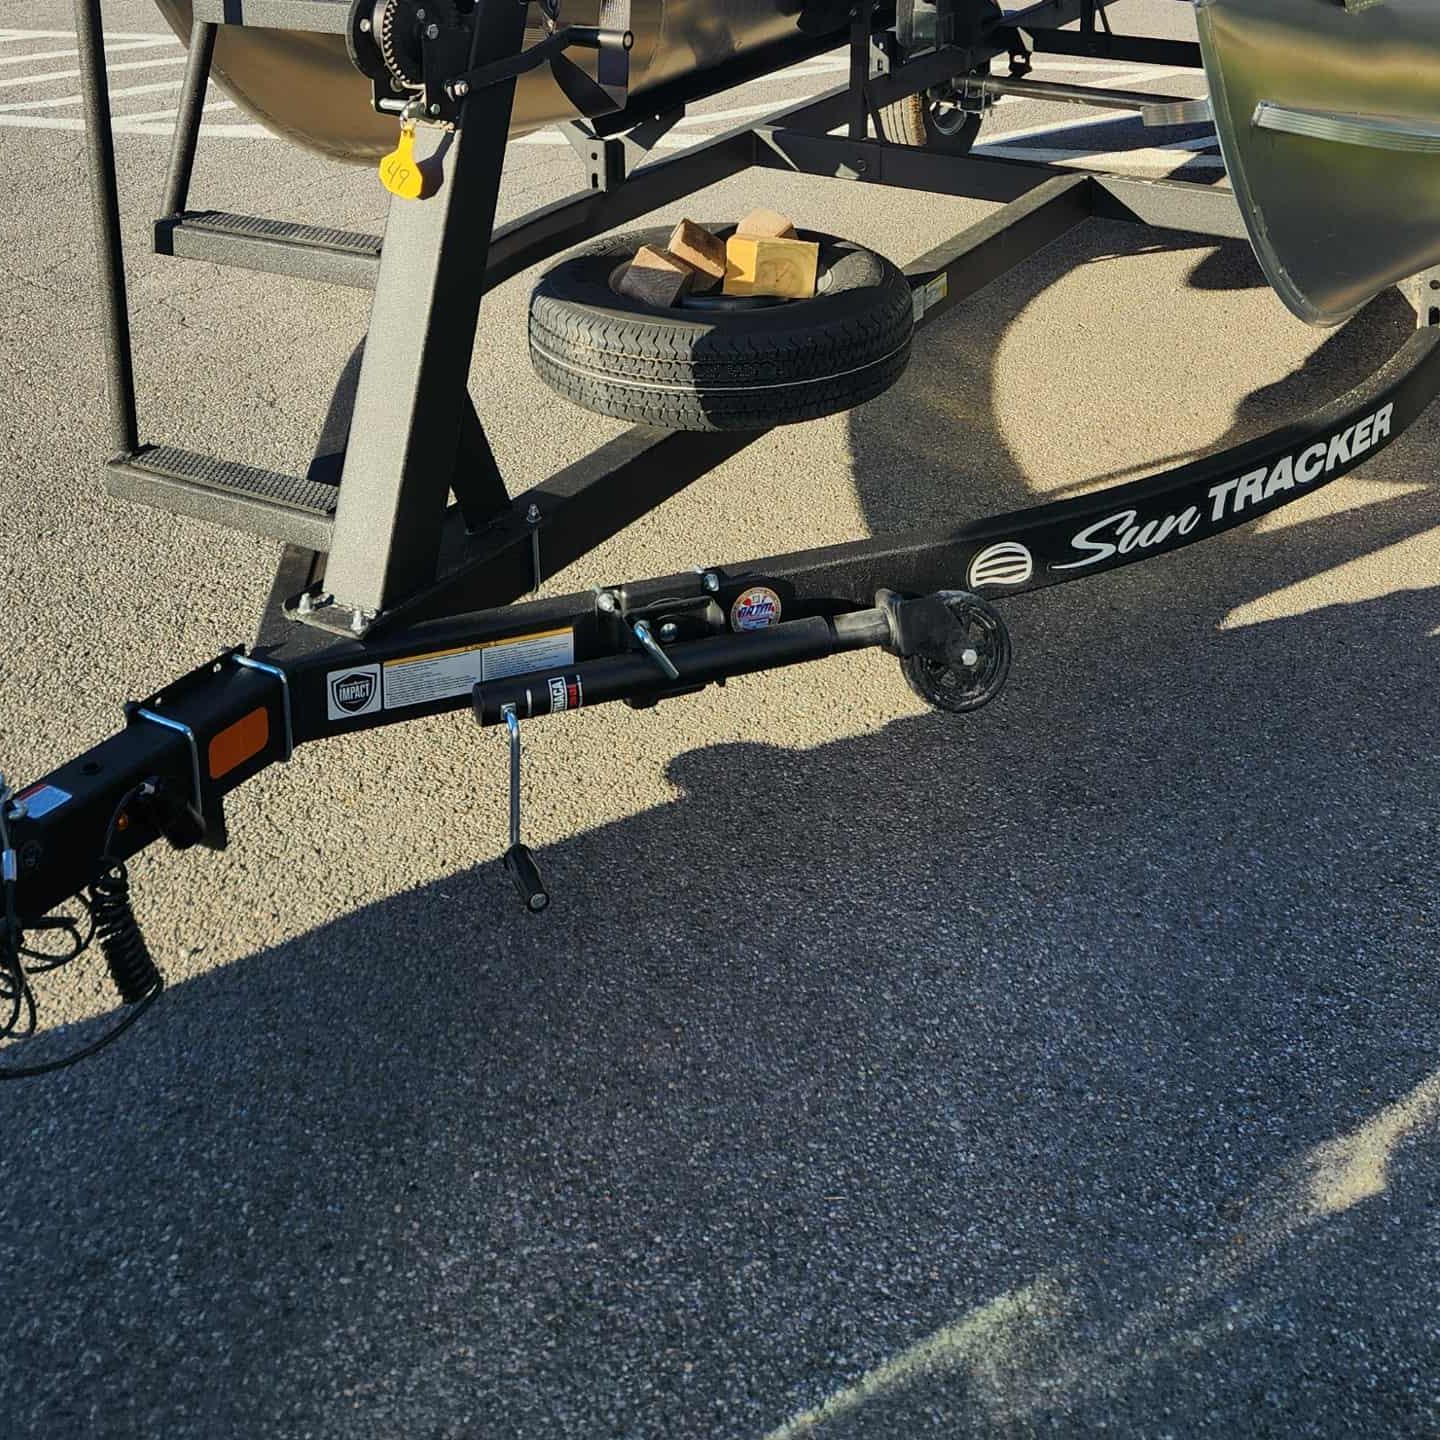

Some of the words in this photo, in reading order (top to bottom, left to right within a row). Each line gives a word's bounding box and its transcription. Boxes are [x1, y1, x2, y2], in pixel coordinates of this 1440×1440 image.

[387, 160, 410, 190] 49
[1051, 505, 1202, 569] Sun
[1207, 402, 1394, 522] TRACKER
[339, 682, 370, 702] IMPACT
